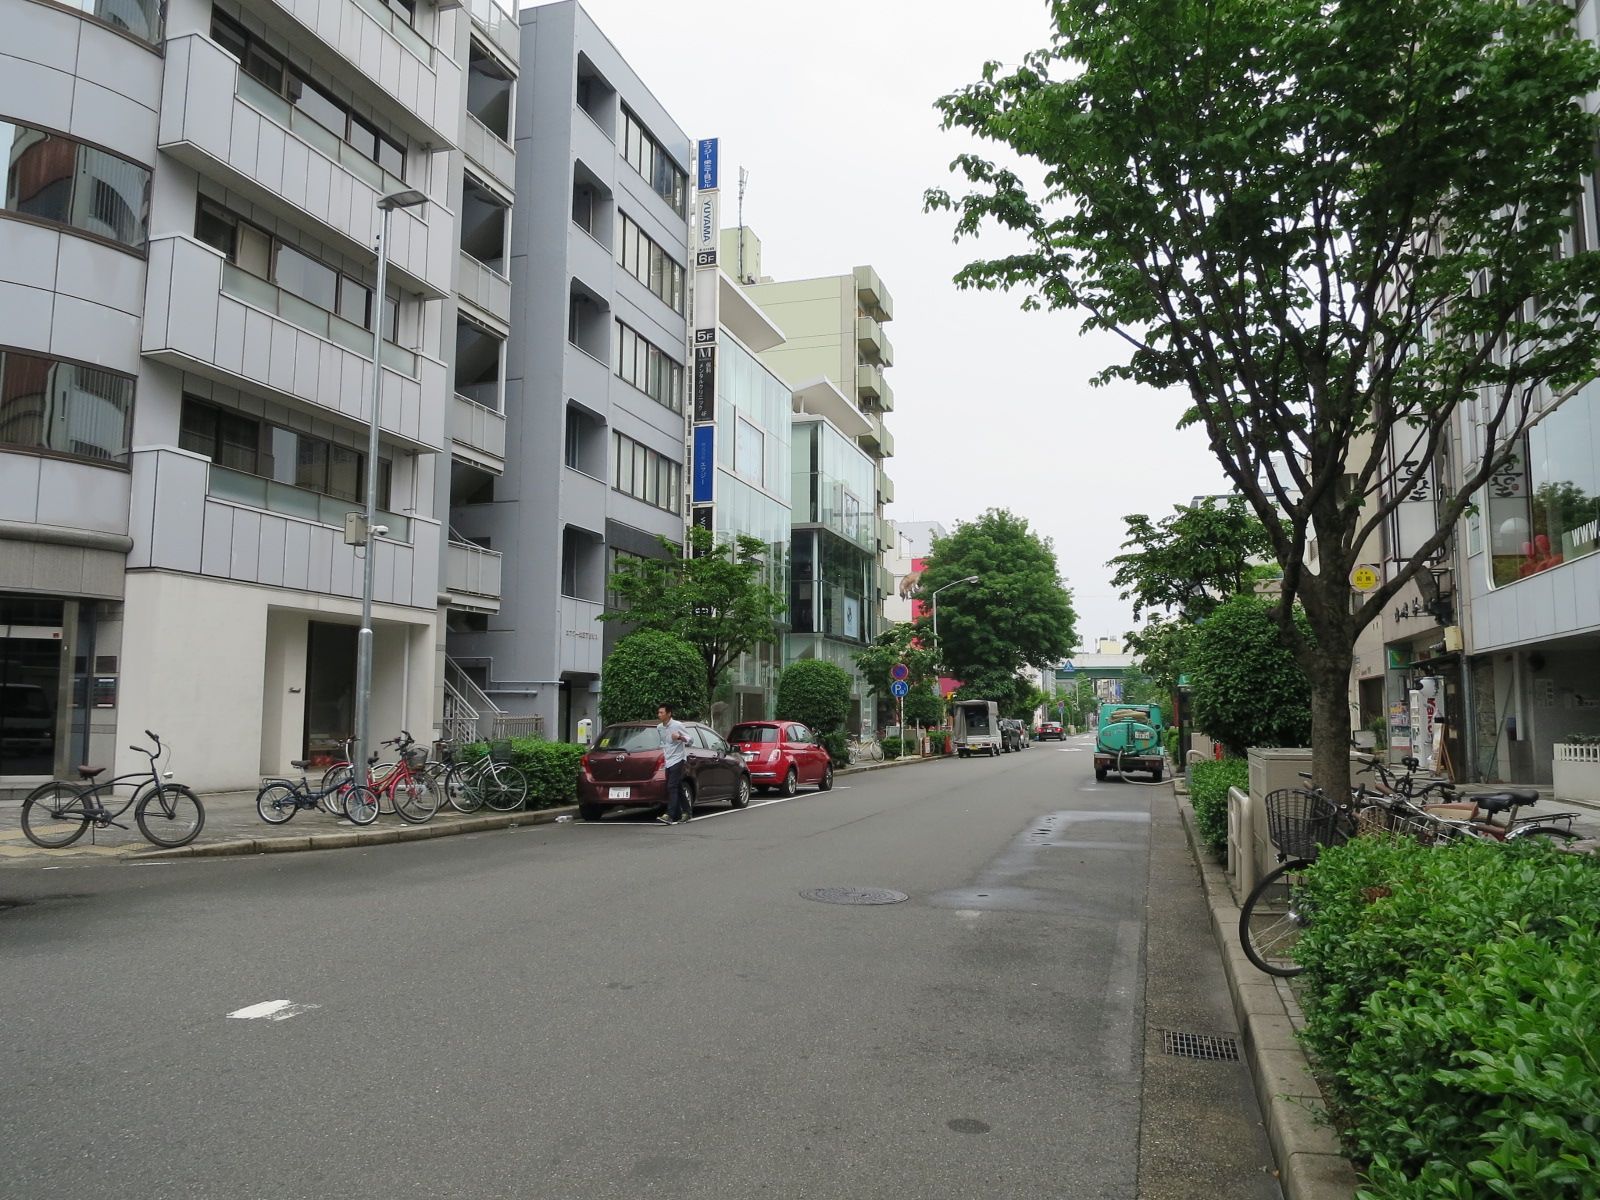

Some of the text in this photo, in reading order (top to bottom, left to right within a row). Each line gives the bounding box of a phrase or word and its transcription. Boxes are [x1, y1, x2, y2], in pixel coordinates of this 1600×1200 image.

[703, 200, 711, 242] YUYAMA
[698, 254, 715, 264] 6F
[697, 331, 714, 341] 5F
